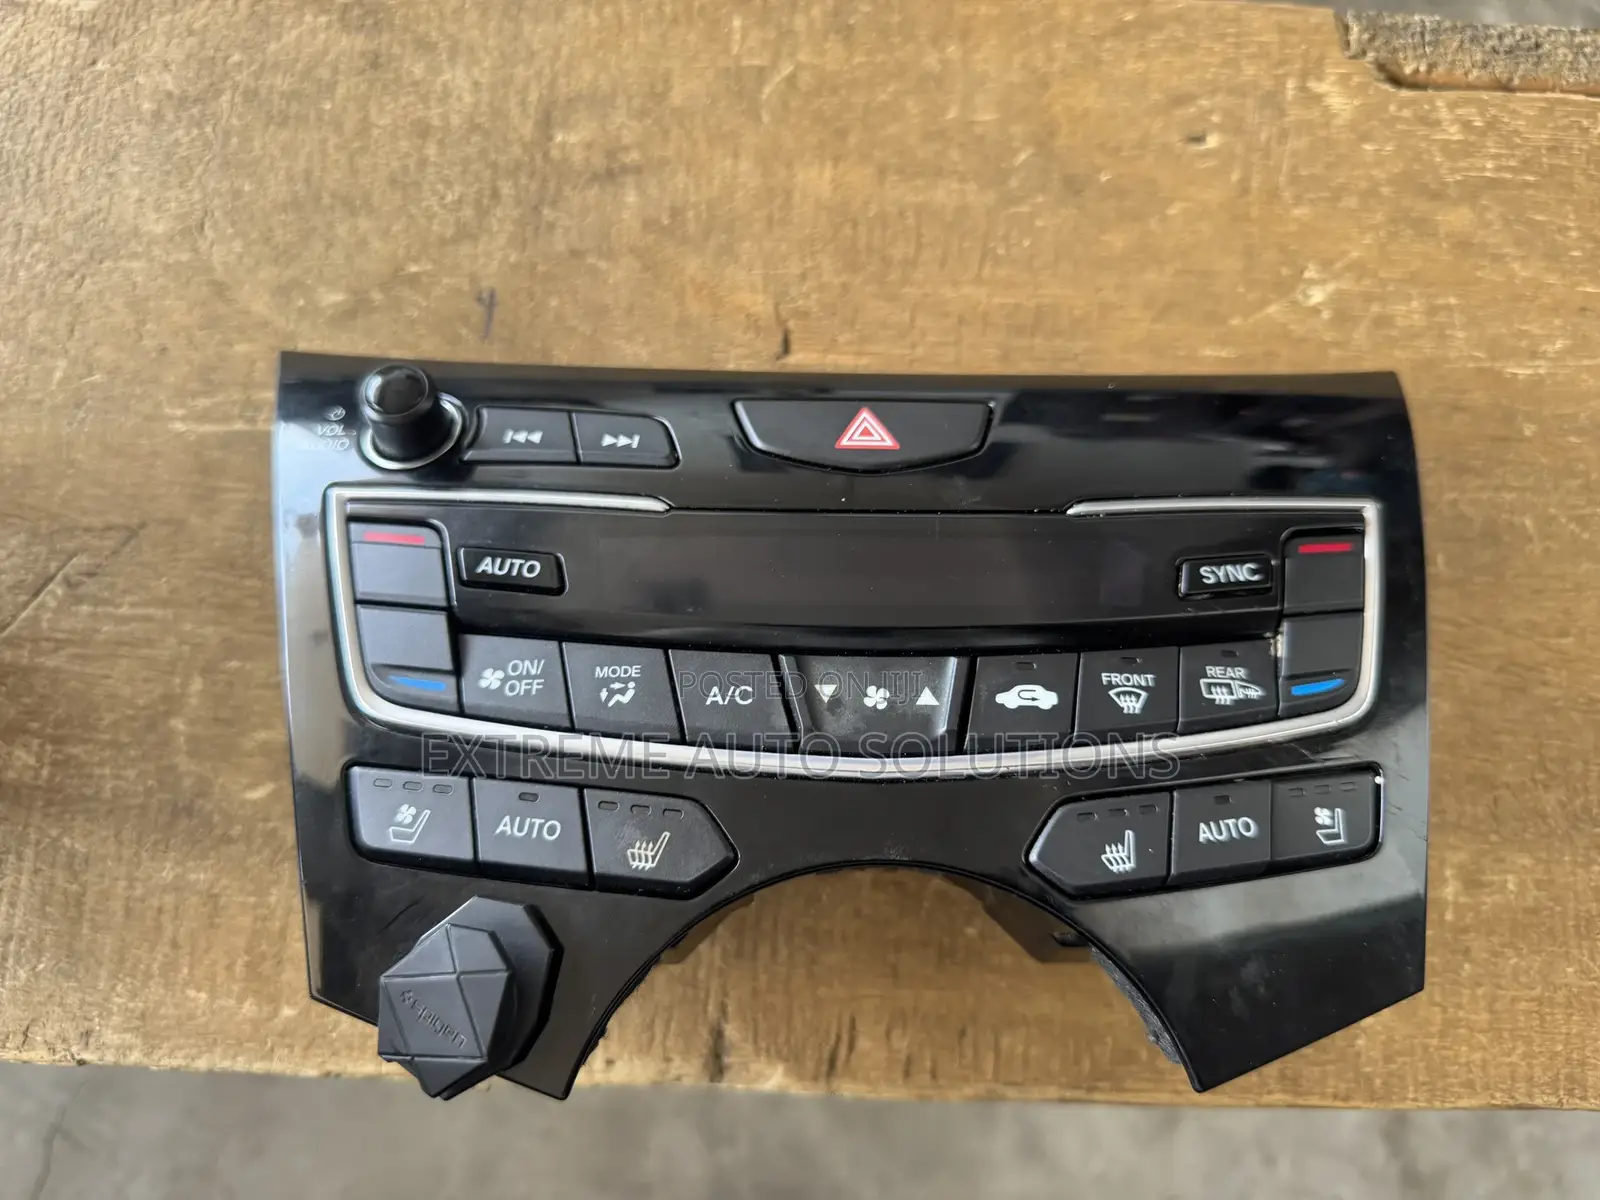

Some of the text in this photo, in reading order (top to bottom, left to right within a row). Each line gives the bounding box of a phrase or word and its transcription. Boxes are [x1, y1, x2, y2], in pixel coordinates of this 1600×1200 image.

[317, 423, 346, 436] VOL
[475, 556, 541, 578] AUTO
[1199, 562, 1265, 584] SYNC
[507, 659, 545, 676] ON/
[595, 665, 642, 678] MODE
[1205, 665, 1249, 679] REAR
[504, 678, 545, 697] OFF
[1101, 672, 1156, 687] FRONT
[705, 685, 754, 706] A/C
[494, 814, 562, 840] AUTO
[1199, 816, 1259, 844] AUTO
